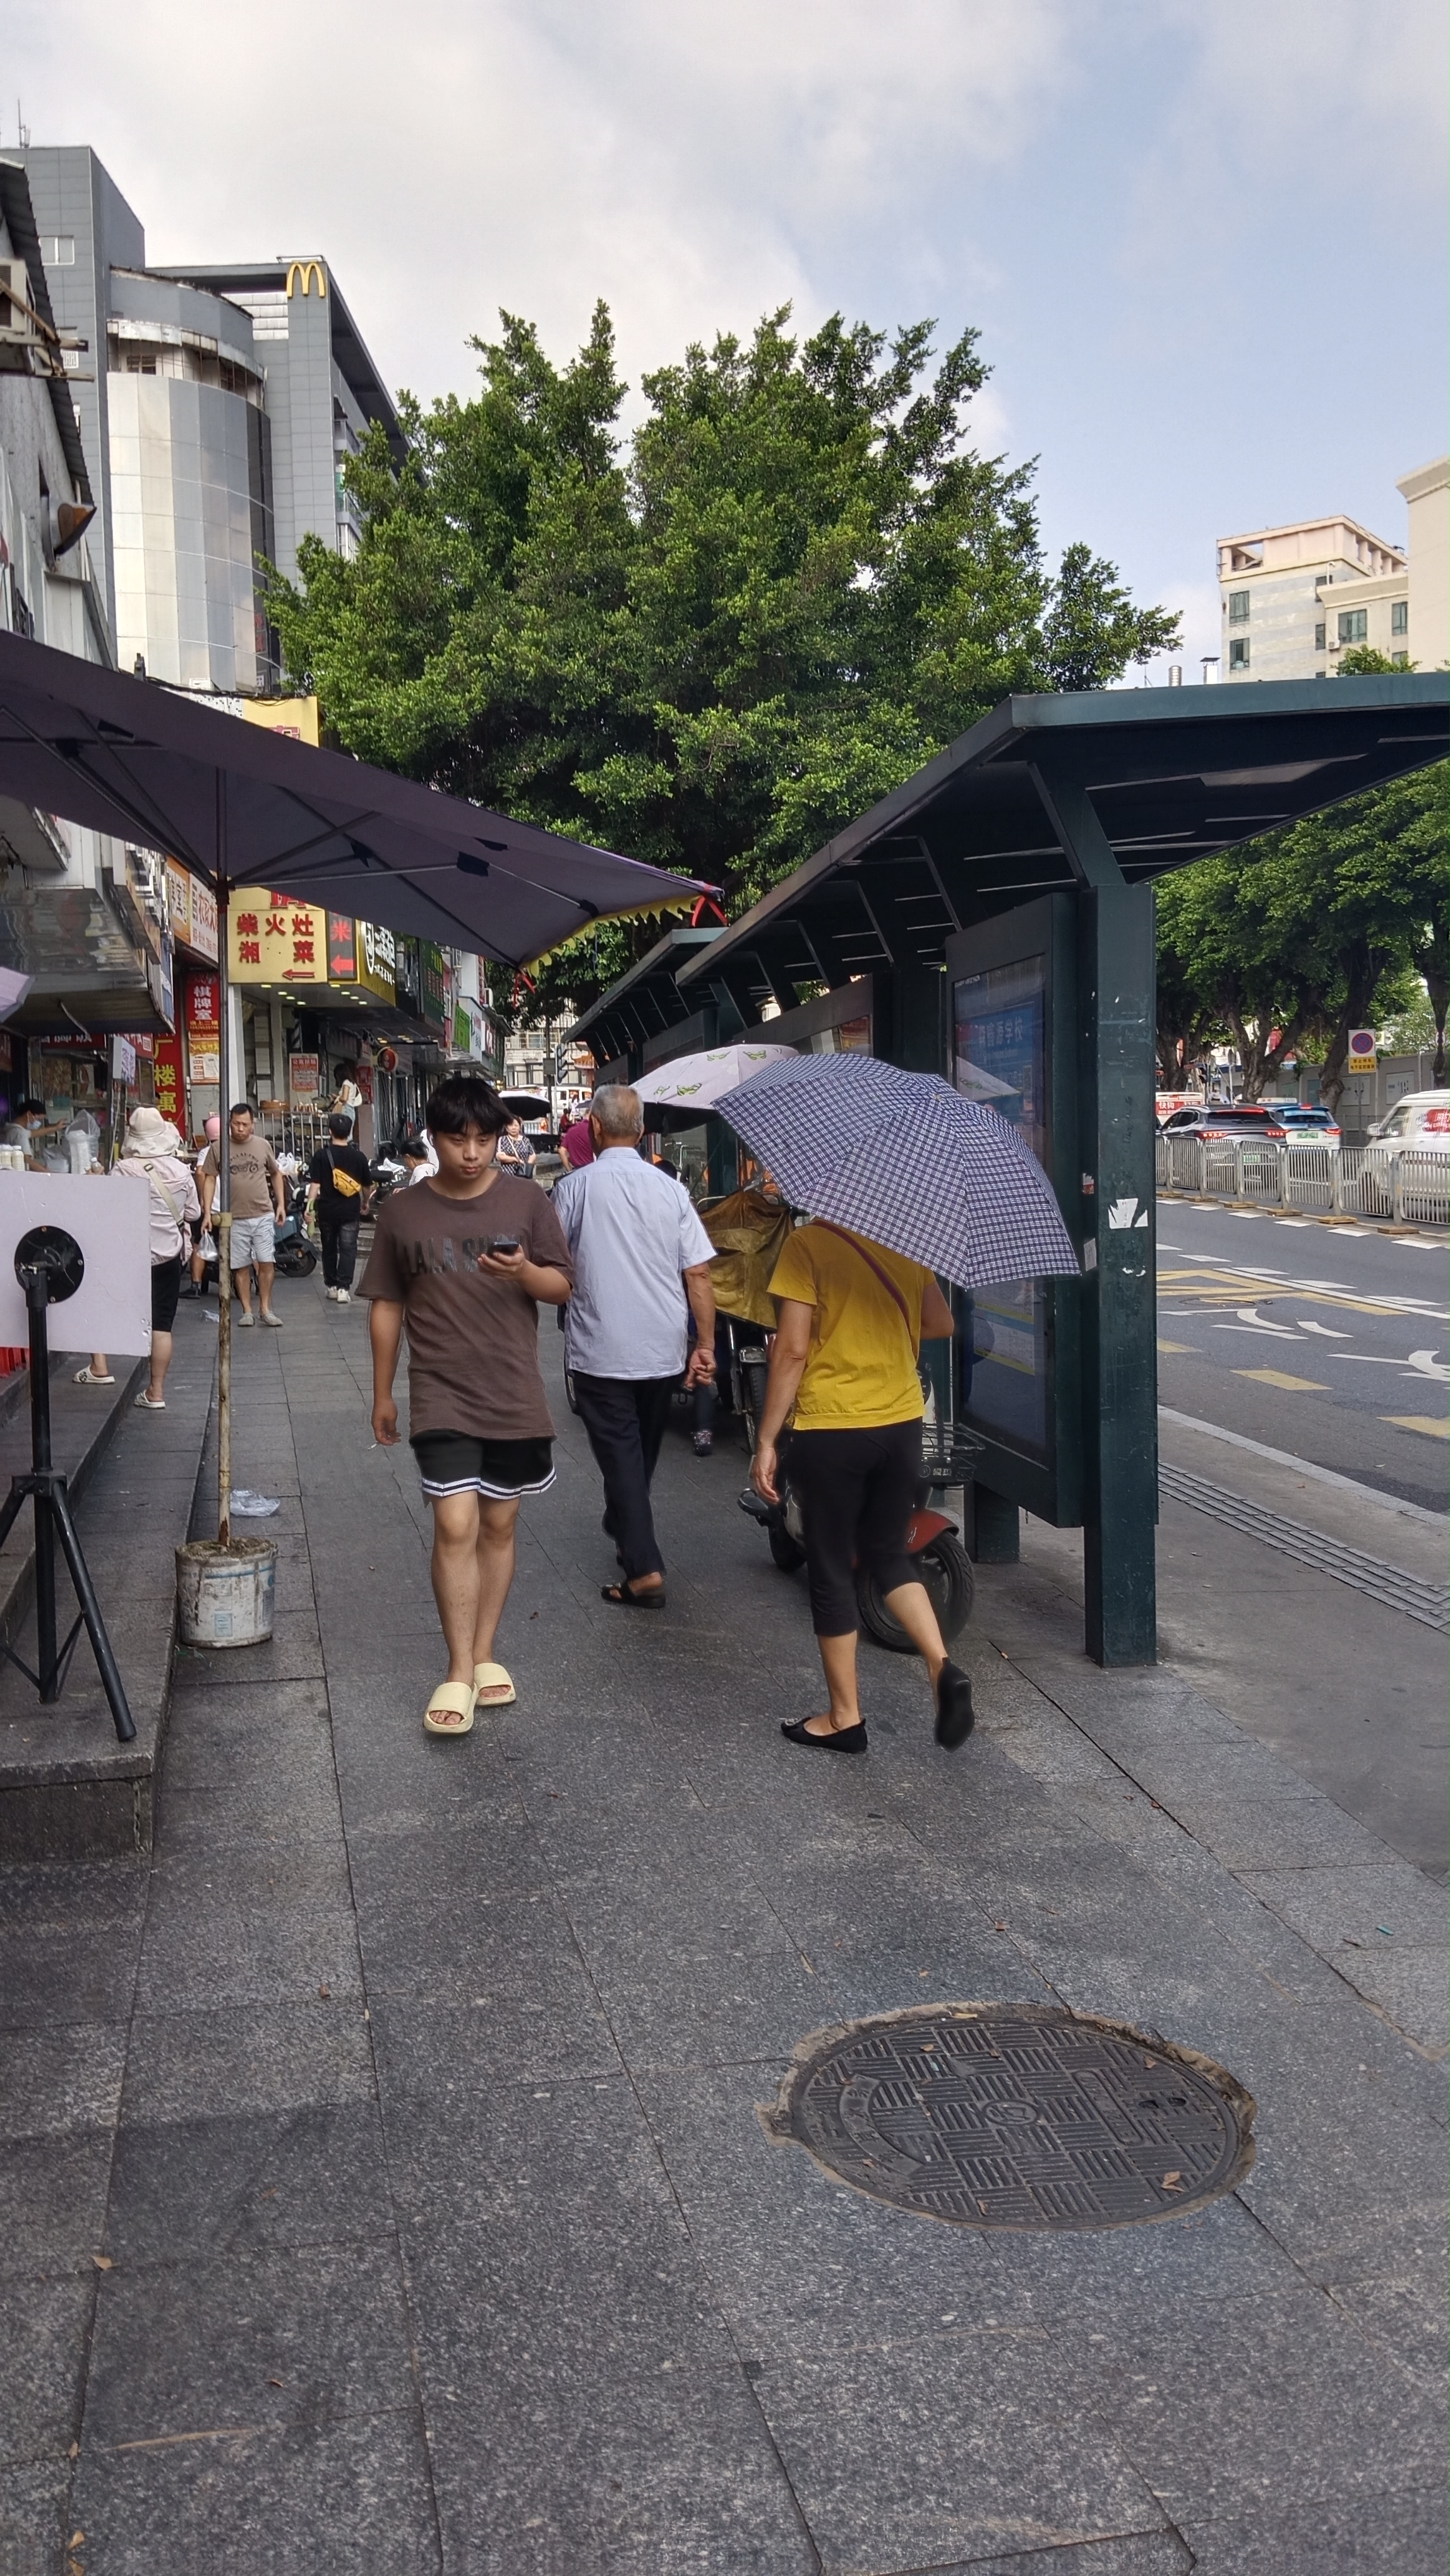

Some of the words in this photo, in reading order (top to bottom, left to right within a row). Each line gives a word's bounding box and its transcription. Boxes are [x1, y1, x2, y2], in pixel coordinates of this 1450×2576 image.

[237, 913, 314, 936] 柴火灶
[194, 986, 212, 1020] 棋牌室
[154, 1039, 177, 1123] 厂楼寓
